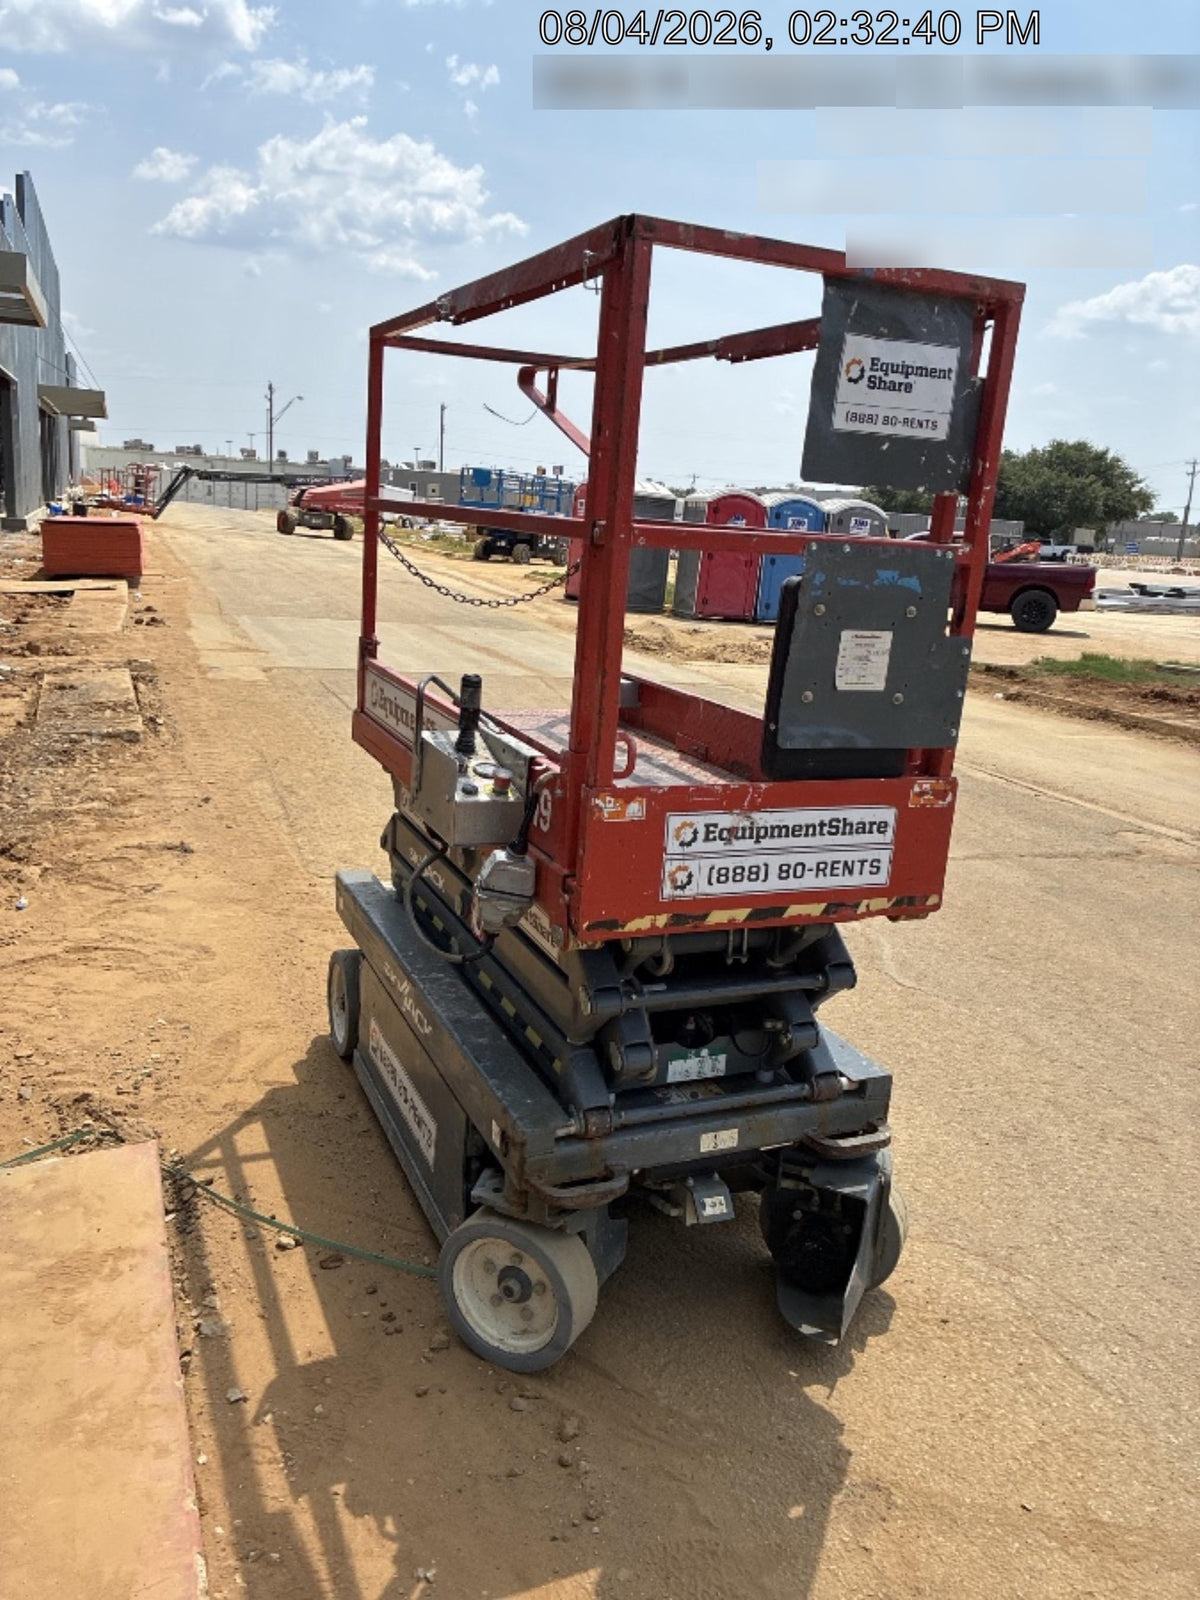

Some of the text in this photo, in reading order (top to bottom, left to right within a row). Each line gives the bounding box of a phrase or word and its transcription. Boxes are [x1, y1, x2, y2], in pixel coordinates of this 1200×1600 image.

[869, 357, 953, 381] Equipment
[866, 375, 914, 394] Share
[845, 410, 938, 431] (888) 80-RENTS
[702, 817, 889, 846] EquipmentShare
[706, 858, 882, 886] (888) 80-RENTS
